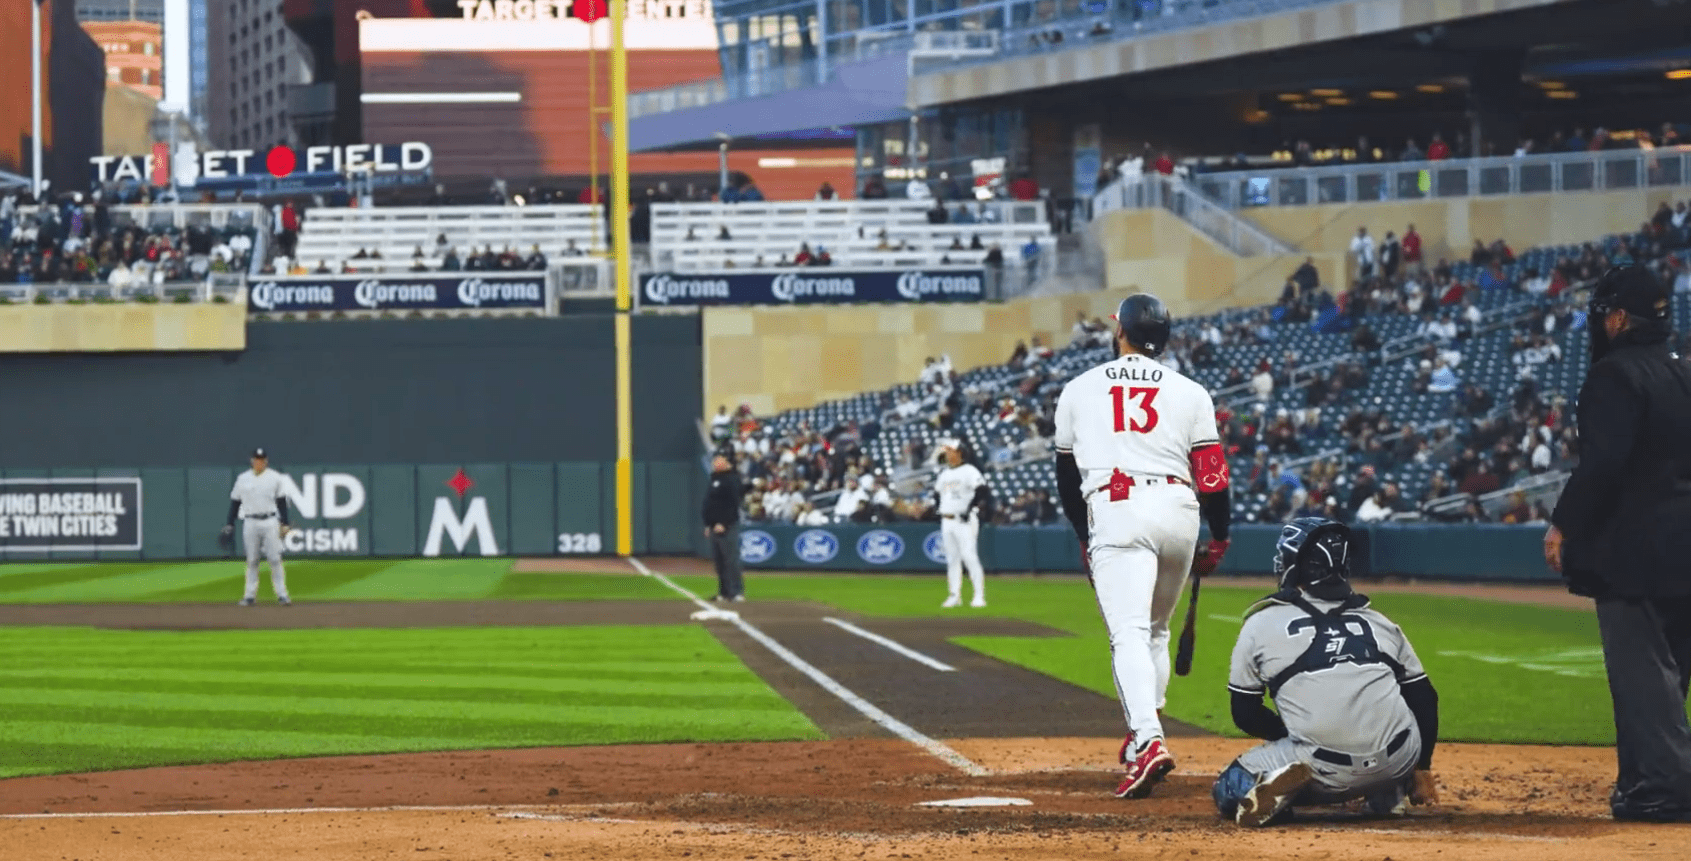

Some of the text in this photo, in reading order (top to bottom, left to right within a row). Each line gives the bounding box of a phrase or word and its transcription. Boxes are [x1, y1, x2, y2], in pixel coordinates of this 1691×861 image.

[457, 0, 713, 19] TARGET ENTE
[307, 141, 432, 173] FIELD
[251, 282, 334, 309] Corona
[354, 280, 437, 308] Corona
[457, 278, 540, 306] Corona
[645, 275, 730, 303] Corona
[771, 273, 855, 301] Corona
[897, 271, 981, 299] Corona
[1105, 367, 1163, 382] GALLO
[1108, 385, 1160, 434] 13
[38, 491, 126, 515] BASEBALL
[12, 515, 59, 537] TWIN
[61, 514, 118, 537] CITIES
[423, 497, 498, 556] M
[558, 532, 602, 553] 328
